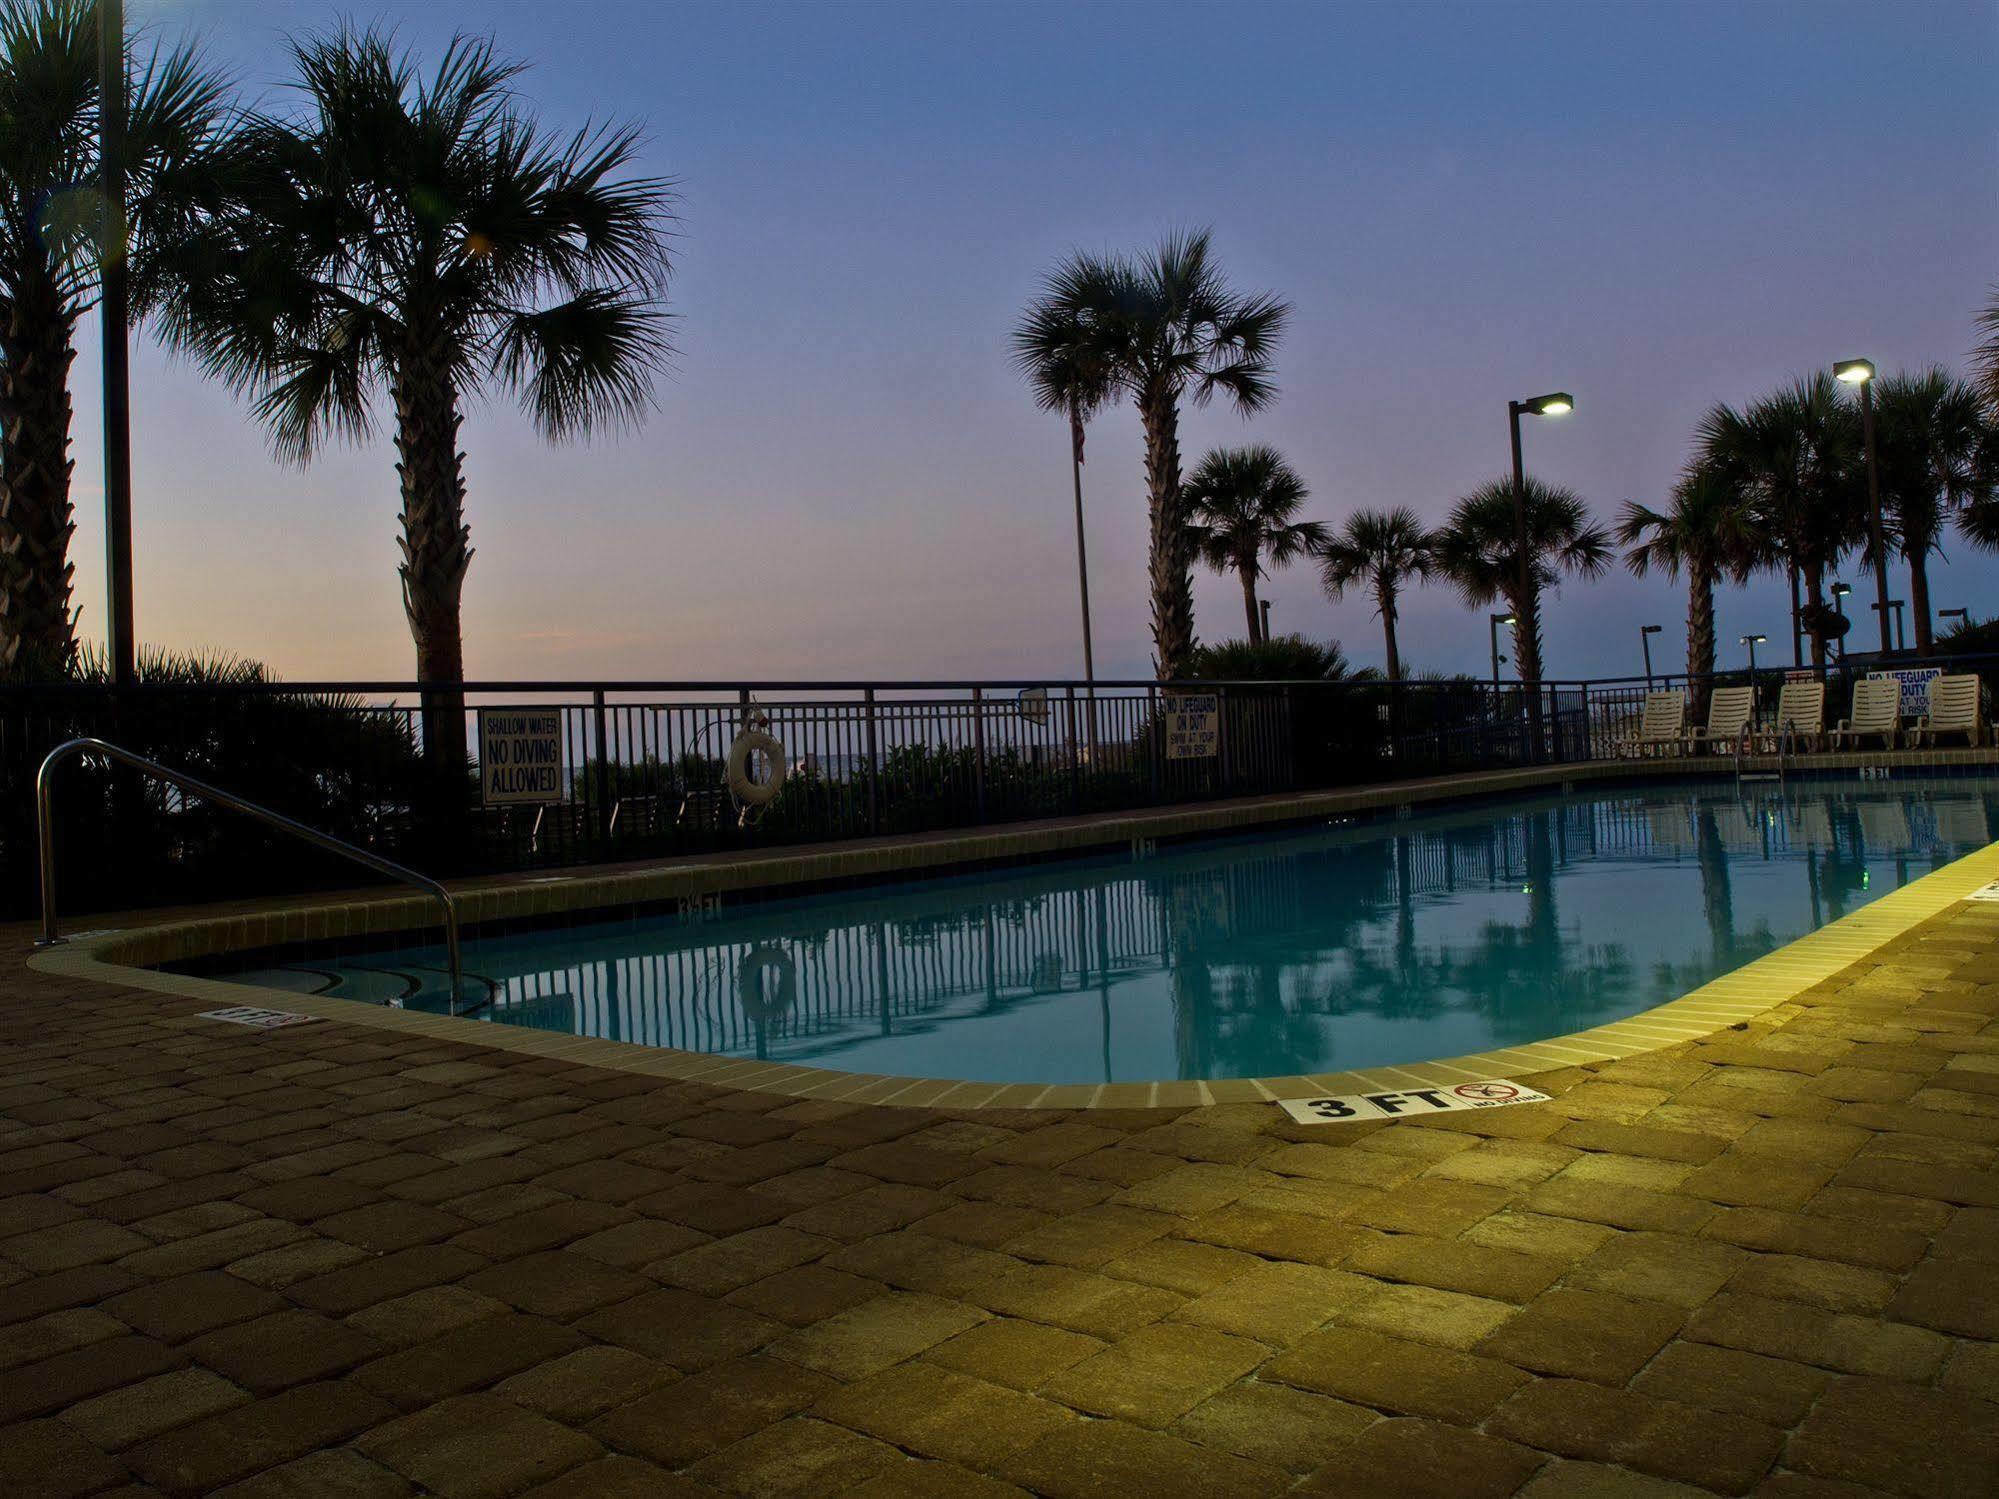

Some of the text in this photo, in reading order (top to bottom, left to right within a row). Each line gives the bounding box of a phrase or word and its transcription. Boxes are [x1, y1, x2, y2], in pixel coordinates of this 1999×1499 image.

[1902, 684, 1926, 696] DUTY
[1167, 697, 1216, 713] NO LIFEGUARD
[1908, 705, 1927, 714] RISK
[488, 718, 557, 734] SHALLOW WATER
[1177, 715, 1187, 730] ON
[489, 740, 557, 764] NO DIVING
[491, 767, 556, 793] ALLOWED
[1307, 1090, 1450, 1118] 3 FT
[1496, 1095, 1545, 1105] DIVING
